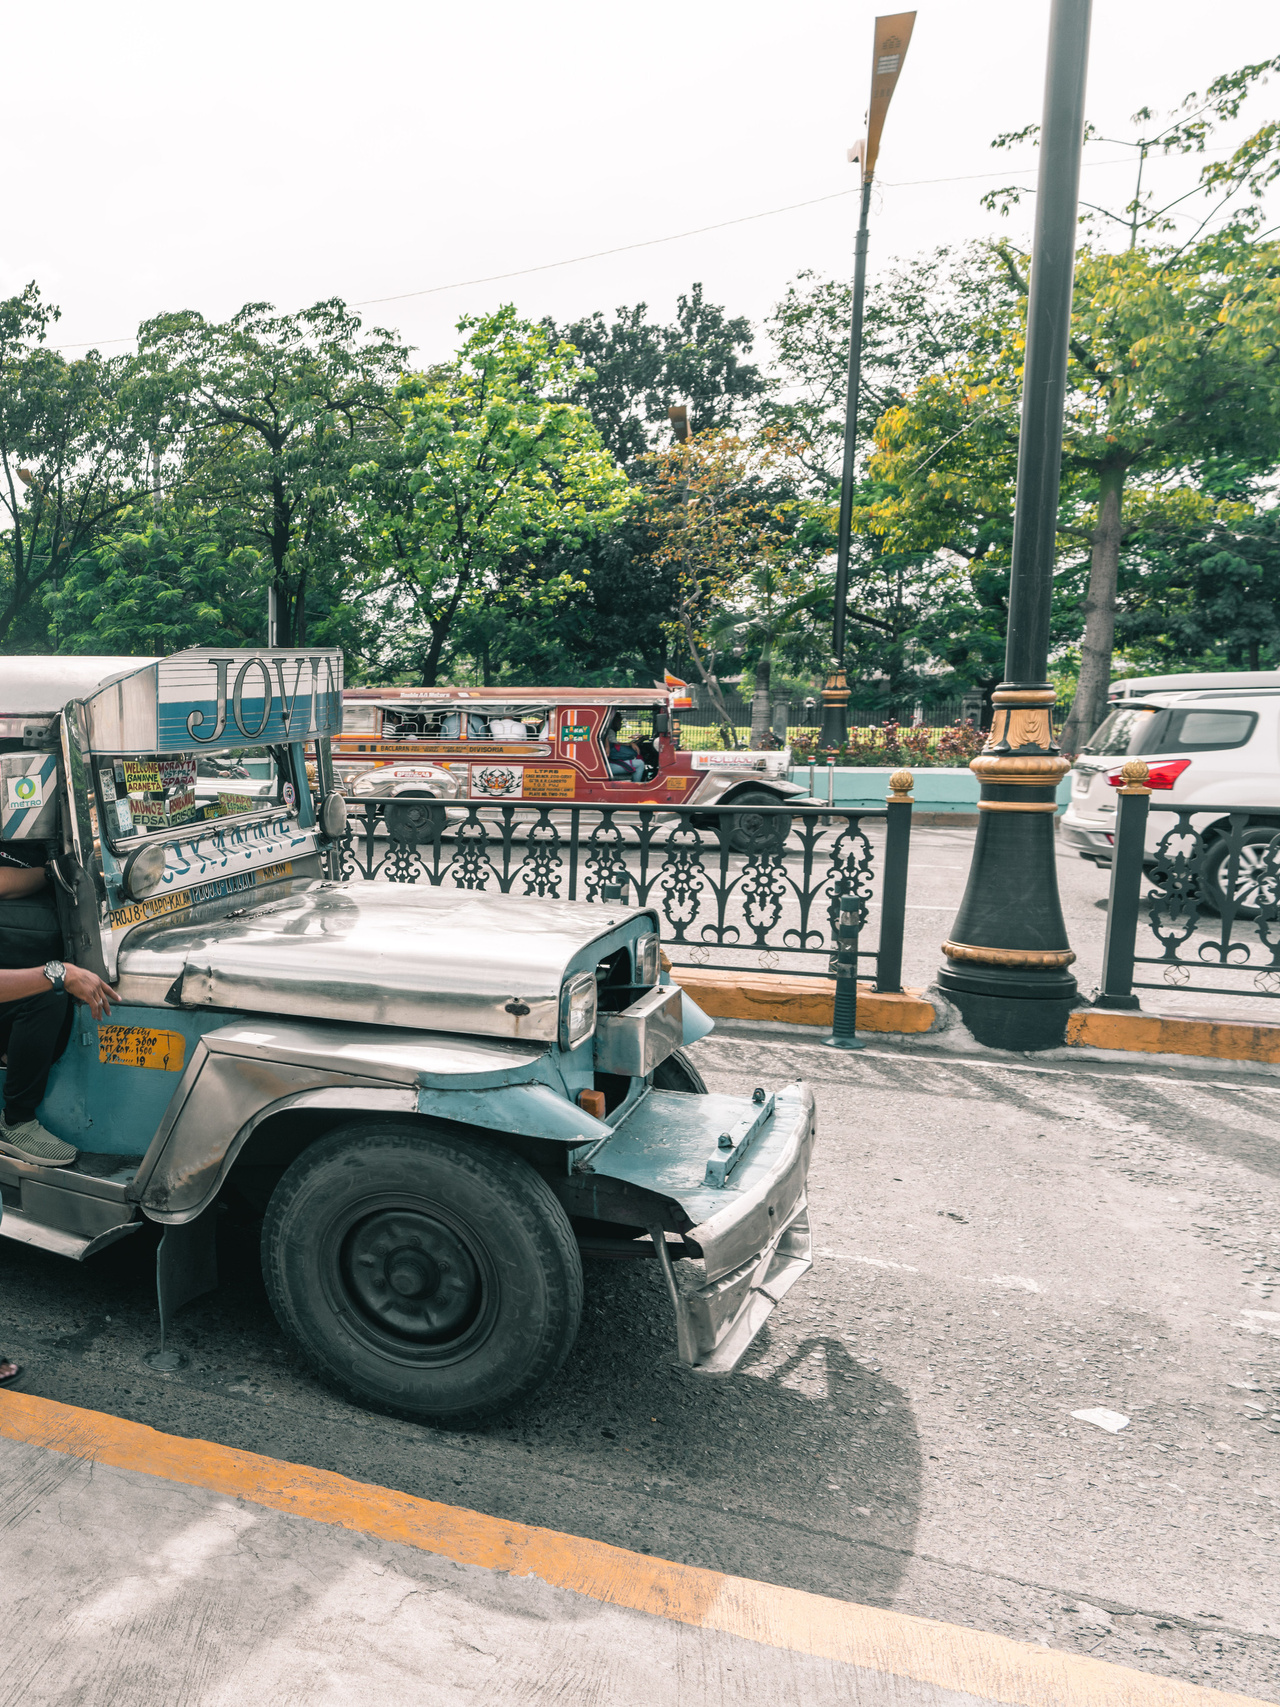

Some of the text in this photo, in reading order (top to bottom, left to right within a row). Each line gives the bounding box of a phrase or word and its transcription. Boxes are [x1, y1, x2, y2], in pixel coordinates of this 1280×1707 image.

[124, 762, 159, 774] WELCOME
[157, 760, 197, 773] MORAYTA
[128, 782, 162, 792] ARANETA
[10, 799, 42, 808] METRO
[133, 814, 167, 825] EDSA
[171, 806, 196, 823] FRISCO
[0, 851, 32, 868] Champi
[105, 1025, 152, 1038] Capacity
[134, 1037, 158, 1047] 3000
[135, 1046, 153, 1056] 1500
